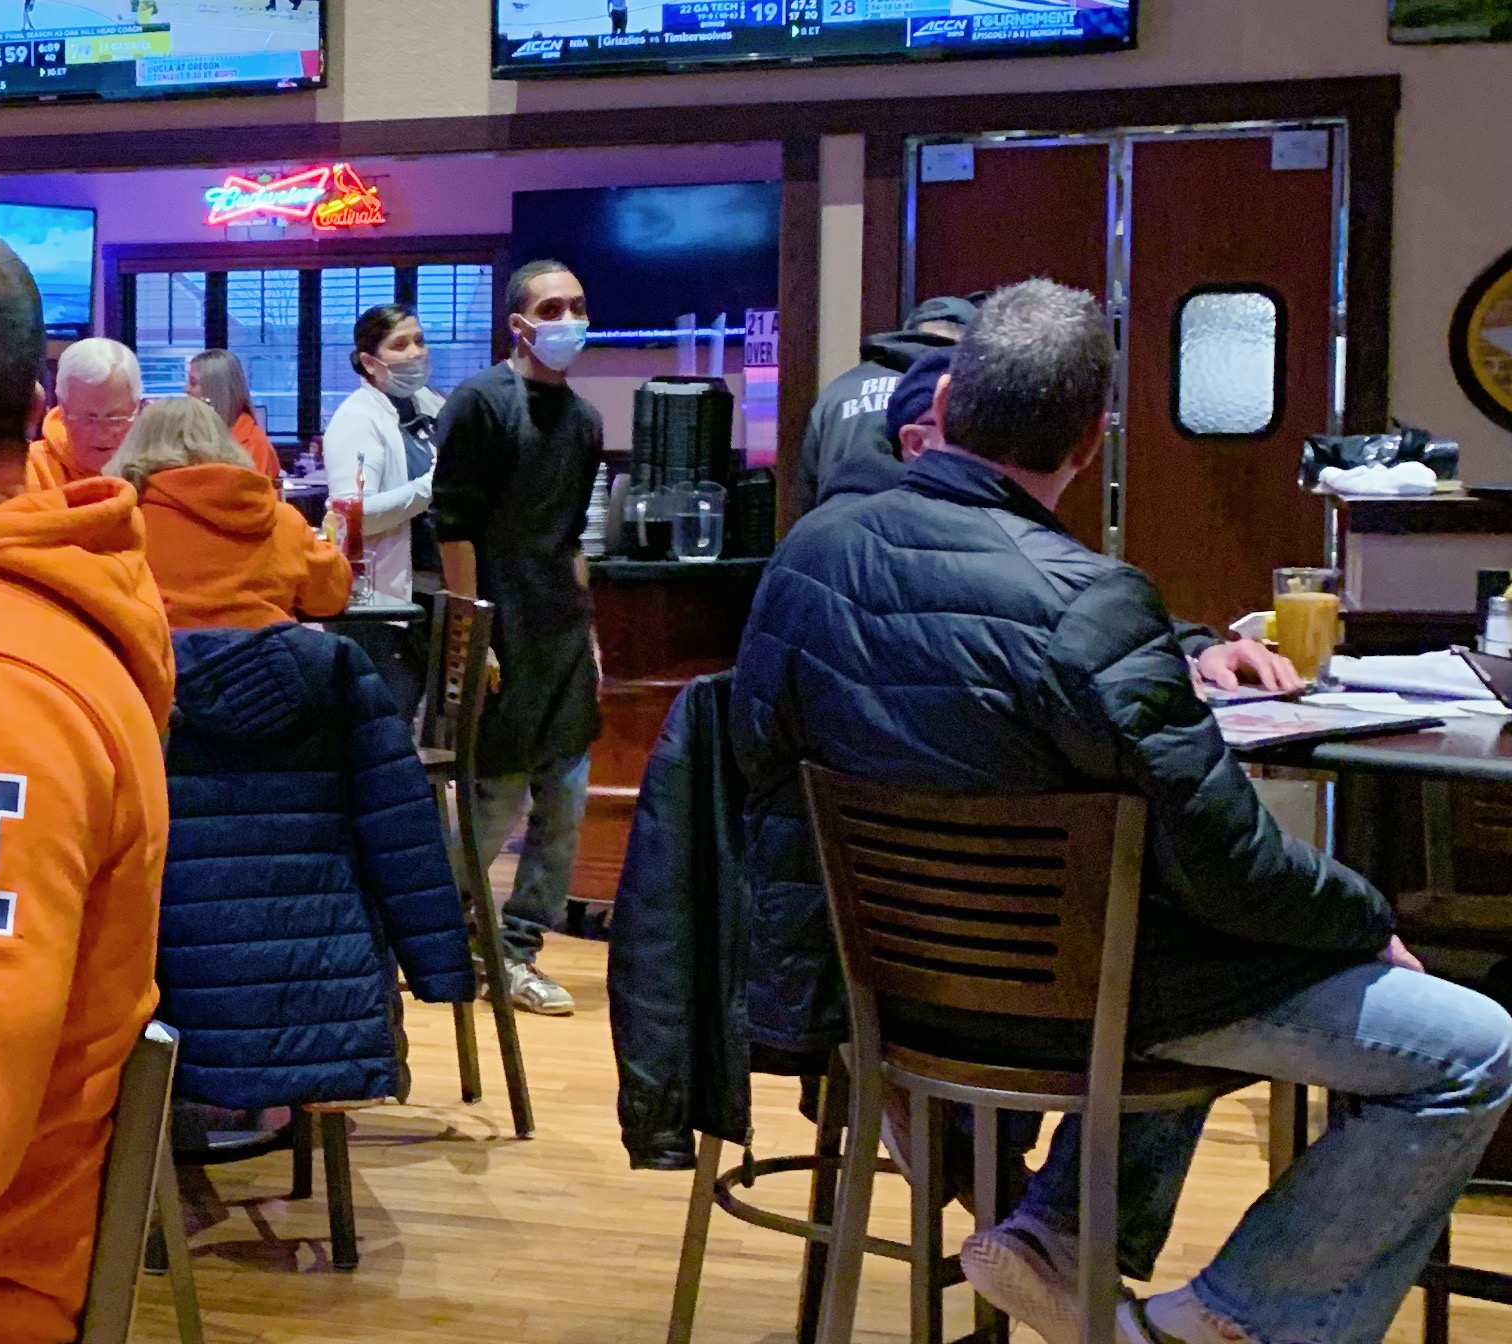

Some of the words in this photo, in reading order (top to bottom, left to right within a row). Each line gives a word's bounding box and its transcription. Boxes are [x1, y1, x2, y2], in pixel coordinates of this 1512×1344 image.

[680, 4, 692, 14] 22
[693, 3, 710, 13] GA
[711, 1, 739, 12] TECH
[751, 2, 778, 22] 19
[790, 0, 818, 11] 47.2
[830, 0, 856, 16] 28
[916, 19, 968, 34] ACCN
[972, 10, 1077, 28] TOURNAMENT
[26, 30, 52, 39] SEASON
[97, 26, 116, 35] HEAD
[117, 25, 143, 34] COACH
[603, 35, 646, 47] Grizzlies
[664, 30, 733, 43] Timberwolves
[4, 46, 29, 63] 59
[516, 39, 564, 54] ACCN
[153, 64, 174, 73] UCLA
[175, 63, 185, 72] AT
[187, 62, 220, 71] OREGON
[205, 186, 326, 212] Budweiser
[312, 205, 386, 231] Cardinals
[747, 313, 765, 337] 21
[745, 341, 774, 364] OVER
